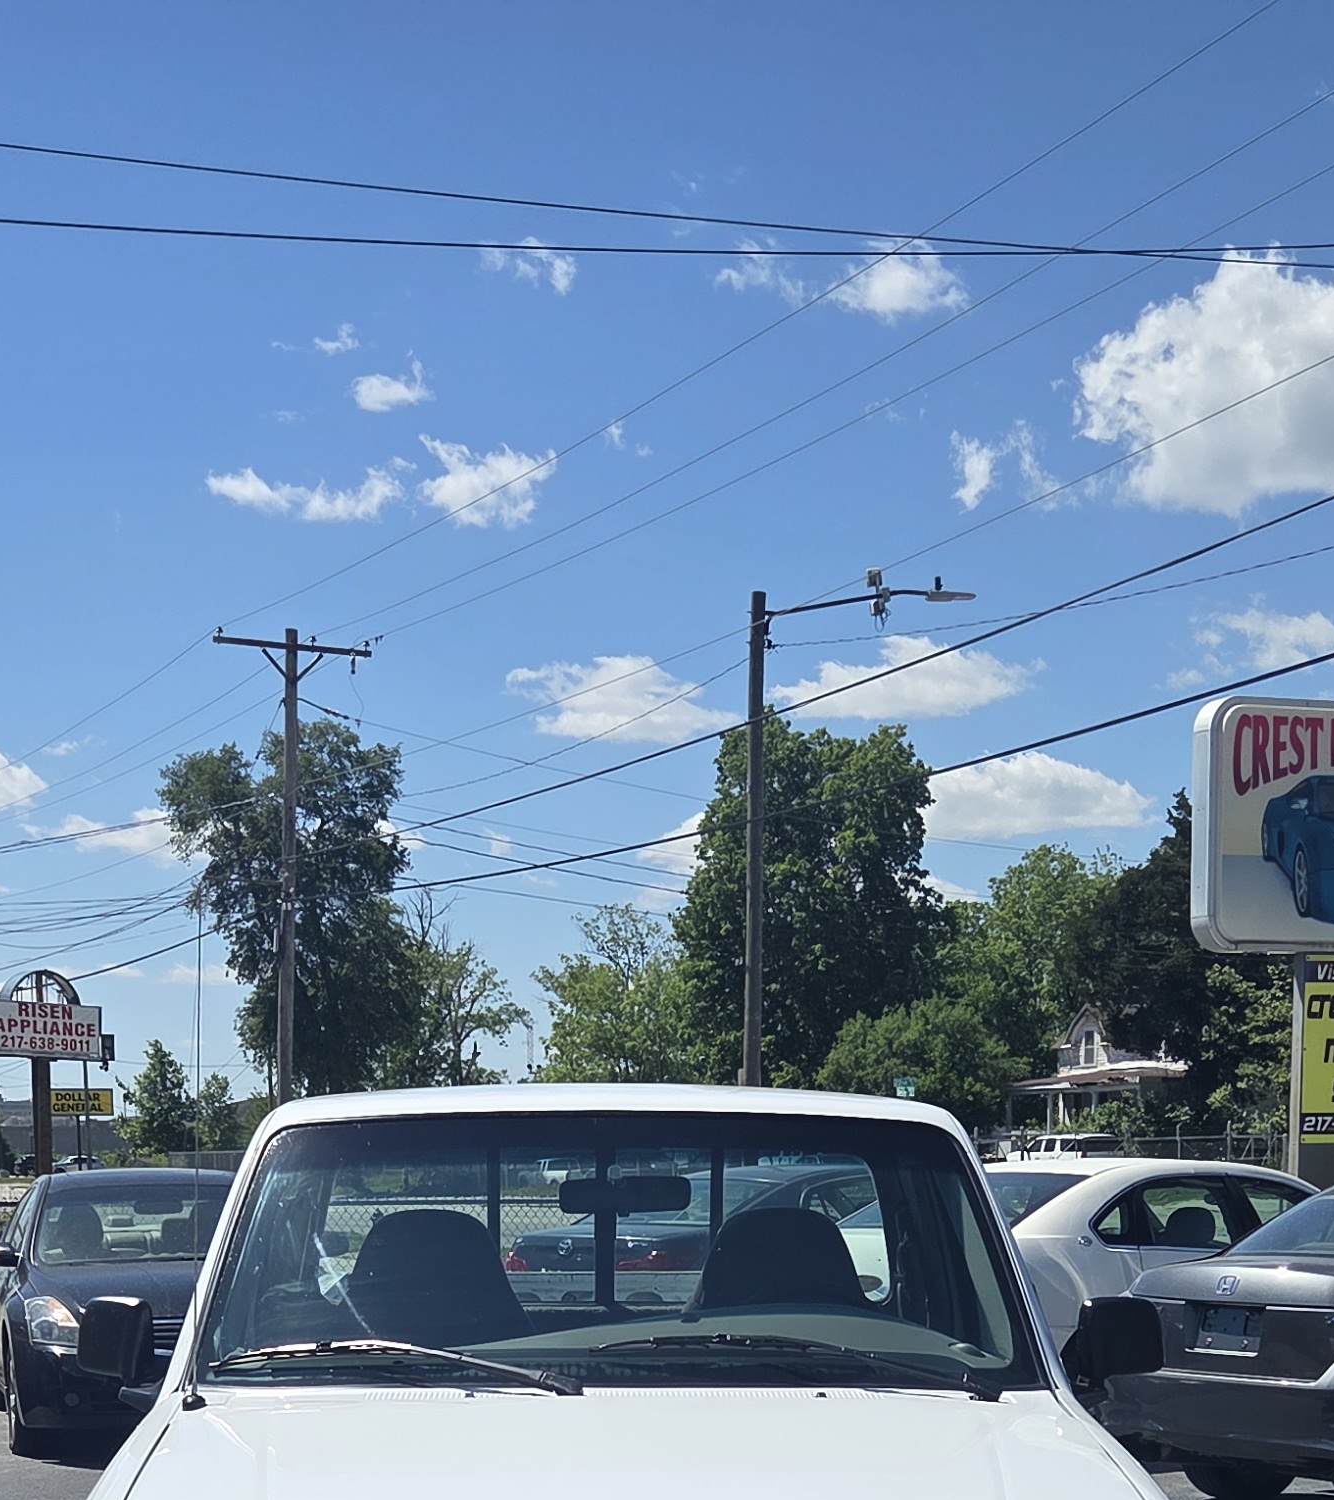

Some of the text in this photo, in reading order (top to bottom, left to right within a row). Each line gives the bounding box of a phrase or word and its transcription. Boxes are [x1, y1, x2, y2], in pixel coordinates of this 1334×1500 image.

[1233, 713, 1324, 796] CREST
[18, 1003, 73, 1020] RISEN
[0, 1035, 90, 1052] 217-638-9011
